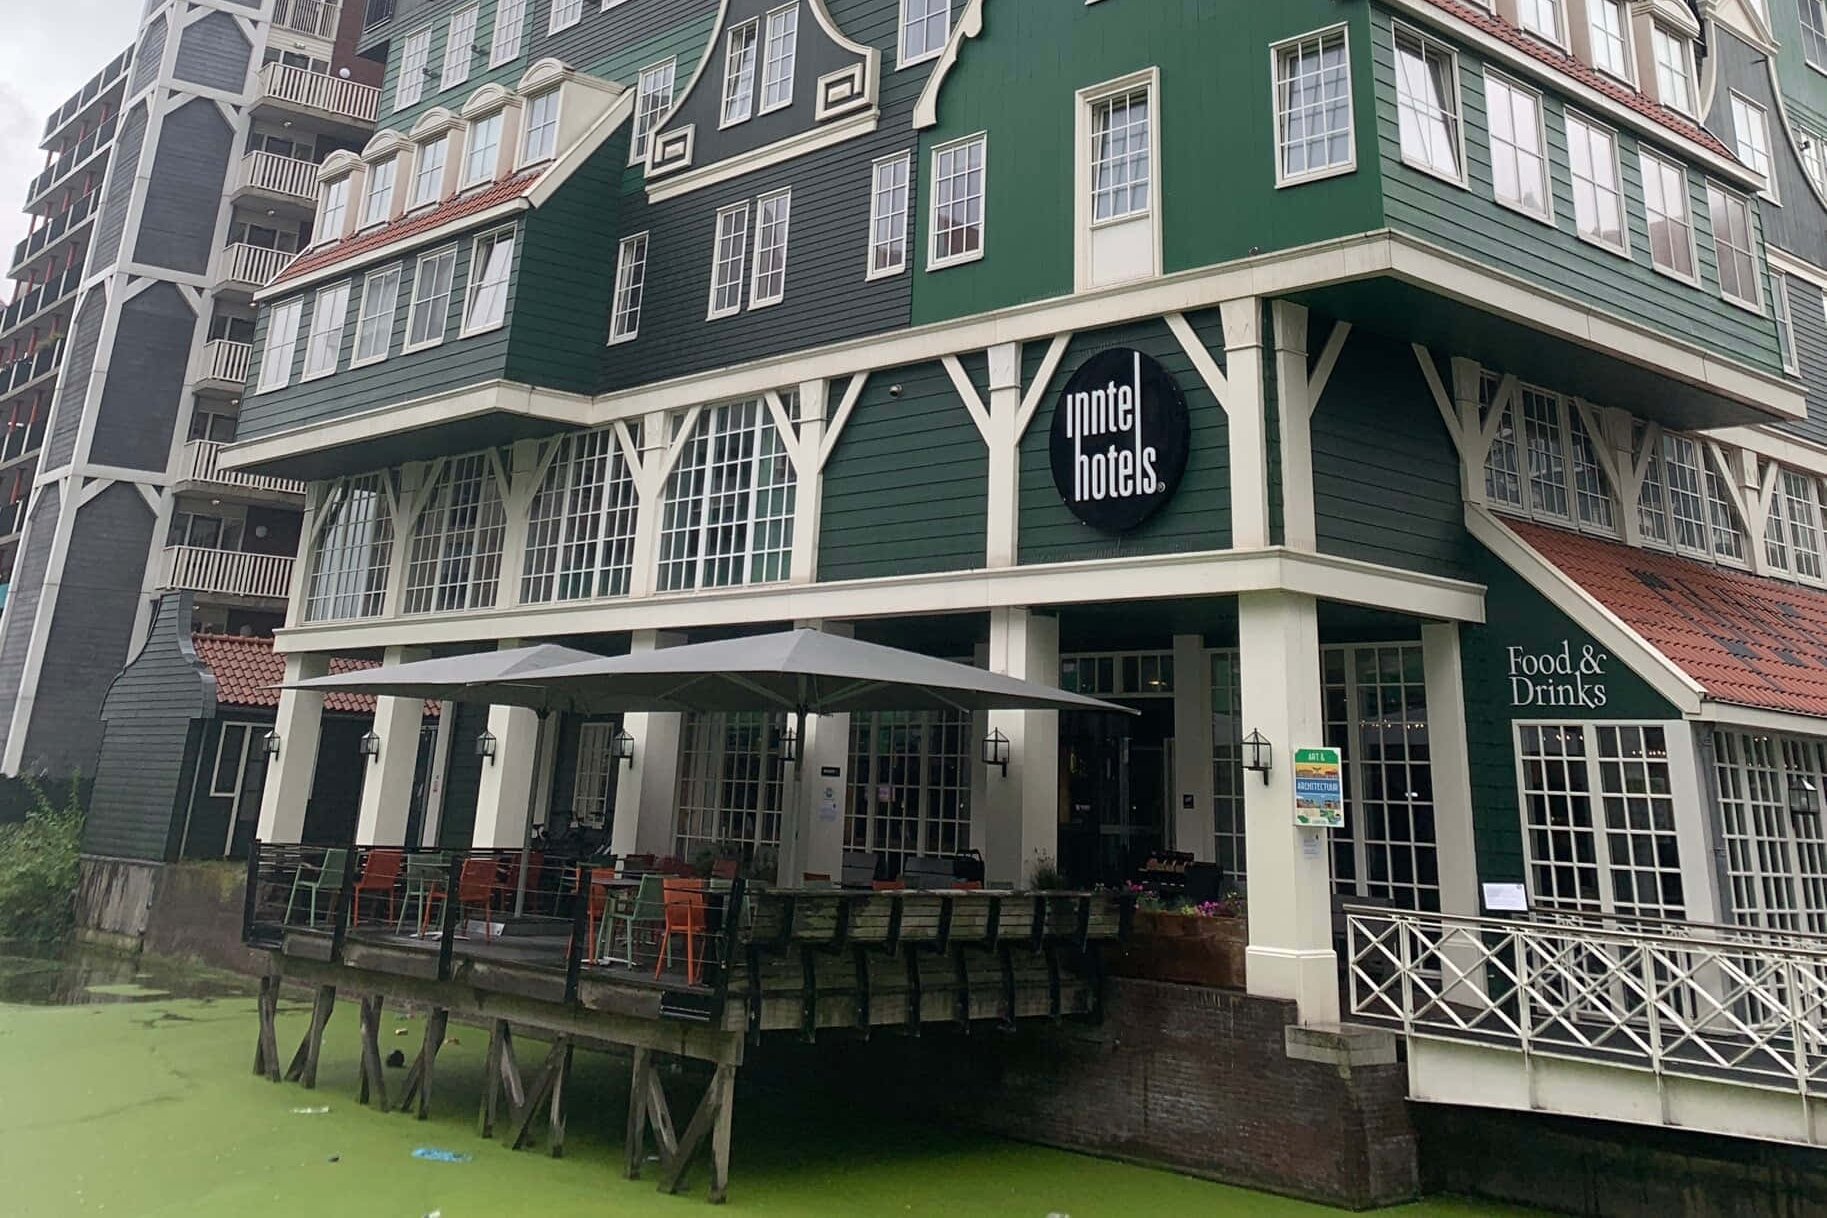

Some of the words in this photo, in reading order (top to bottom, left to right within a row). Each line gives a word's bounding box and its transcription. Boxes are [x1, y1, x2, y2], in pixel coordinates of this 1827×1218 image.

[1066, 351, 1141, 439] inntel
[1074, 443, 1157, 502] hotels
[1506, 639, 1573, 676] Food
[1580, 644, 1607, 675] &
[1508, 669, 1607, 709] Drinks
